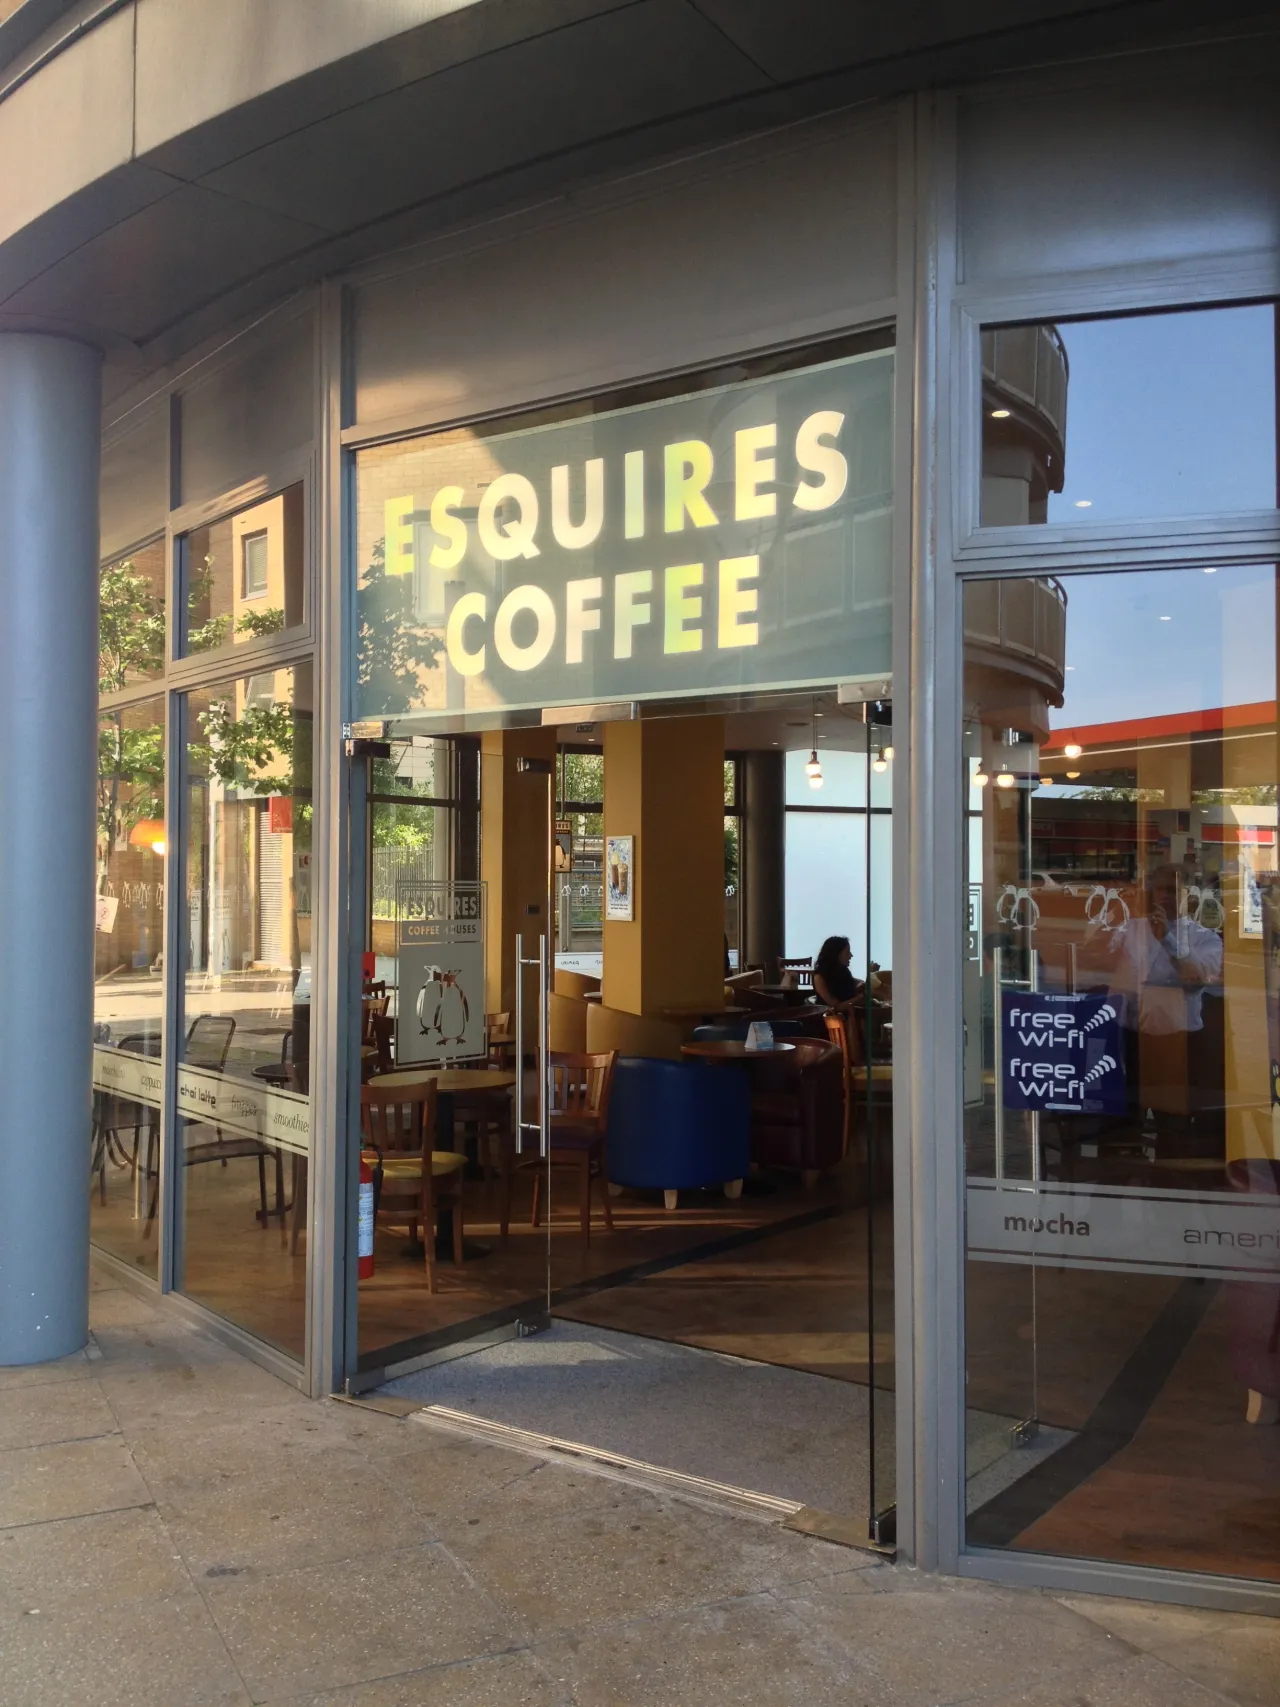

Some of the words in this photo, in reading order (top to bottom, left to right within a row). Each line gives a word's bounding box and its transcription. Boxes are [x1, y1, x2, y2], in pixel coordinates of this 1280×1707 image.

[384, 410, 848, 576] ESQUIRES
[445, 554, 760, 677] COFFEE
[406, 896, 477, 919] ESQUIRES
[407, 924, 440, 936] COFFEE
[1009, 1008, 1076, 1029] free
[1017, 1029, 1084, 1049] wi-fi
[1010, 1058, 1076, 1080] free
[180, 1083, 197, 1099] chai
[198, 1087, 217, 1109] latte
[1018, 1080, 1085, 1099] wi-fi
[1003, 1213, 1091, 1237] mocha
[1183, 1228, 1280, 1249] ameri
